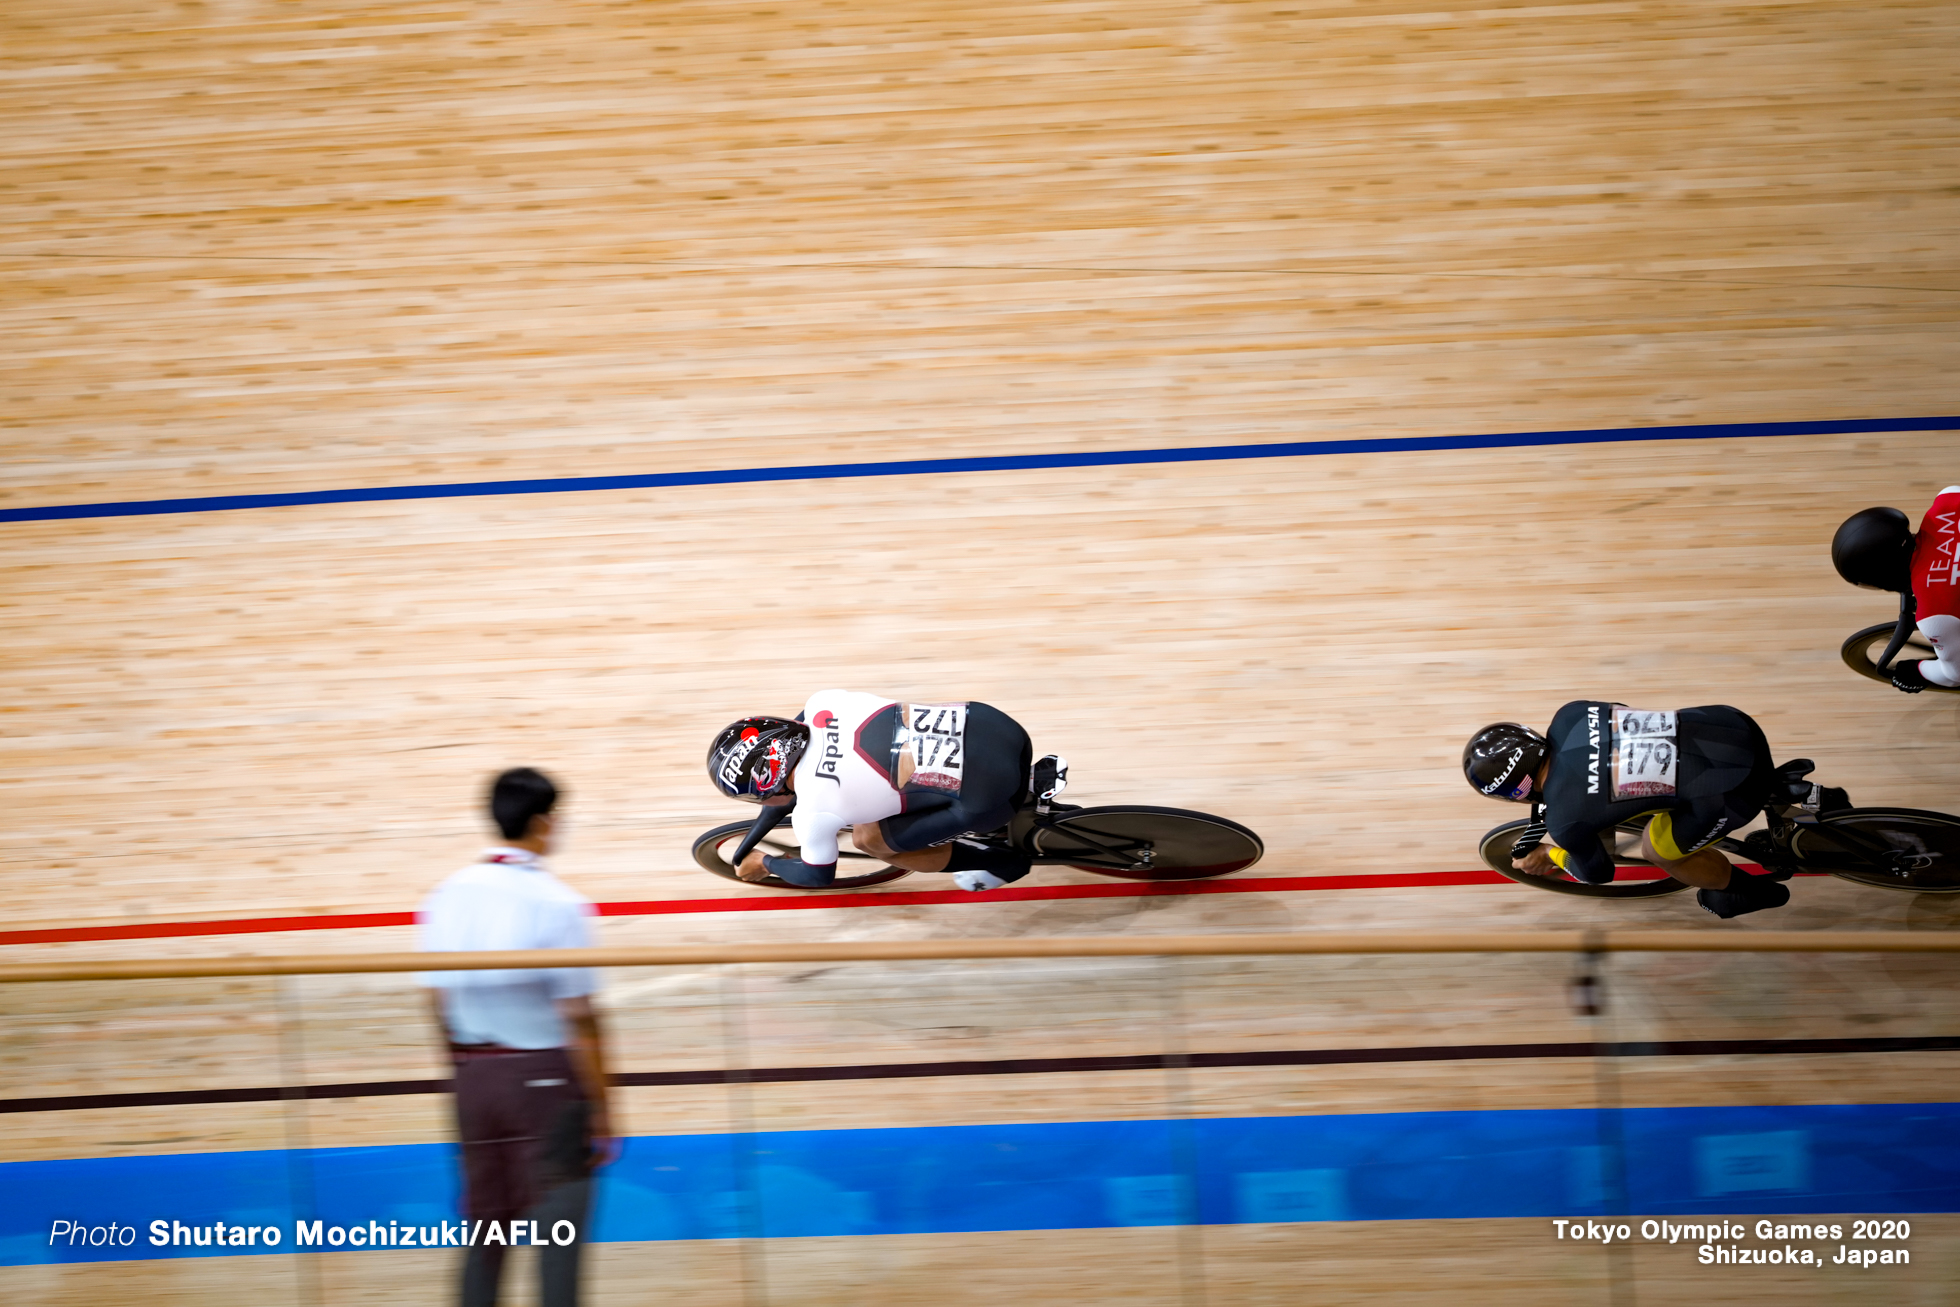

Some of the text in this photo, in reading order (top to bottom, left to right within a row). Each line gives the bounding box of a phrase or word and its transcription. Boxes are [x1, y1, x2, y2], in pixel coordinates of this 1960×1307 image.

[1927, 511, 1956, 588] TEAM
[912, 735, 961, 769] 172
[913, 708, 962, 737] 172
[1587, 706, 1600, 794] MALAYSIA
[718, 735, 760, 795] Japan
[815, 717, 844, 789] Japan
[1622, 742, 1673, 776] 179
